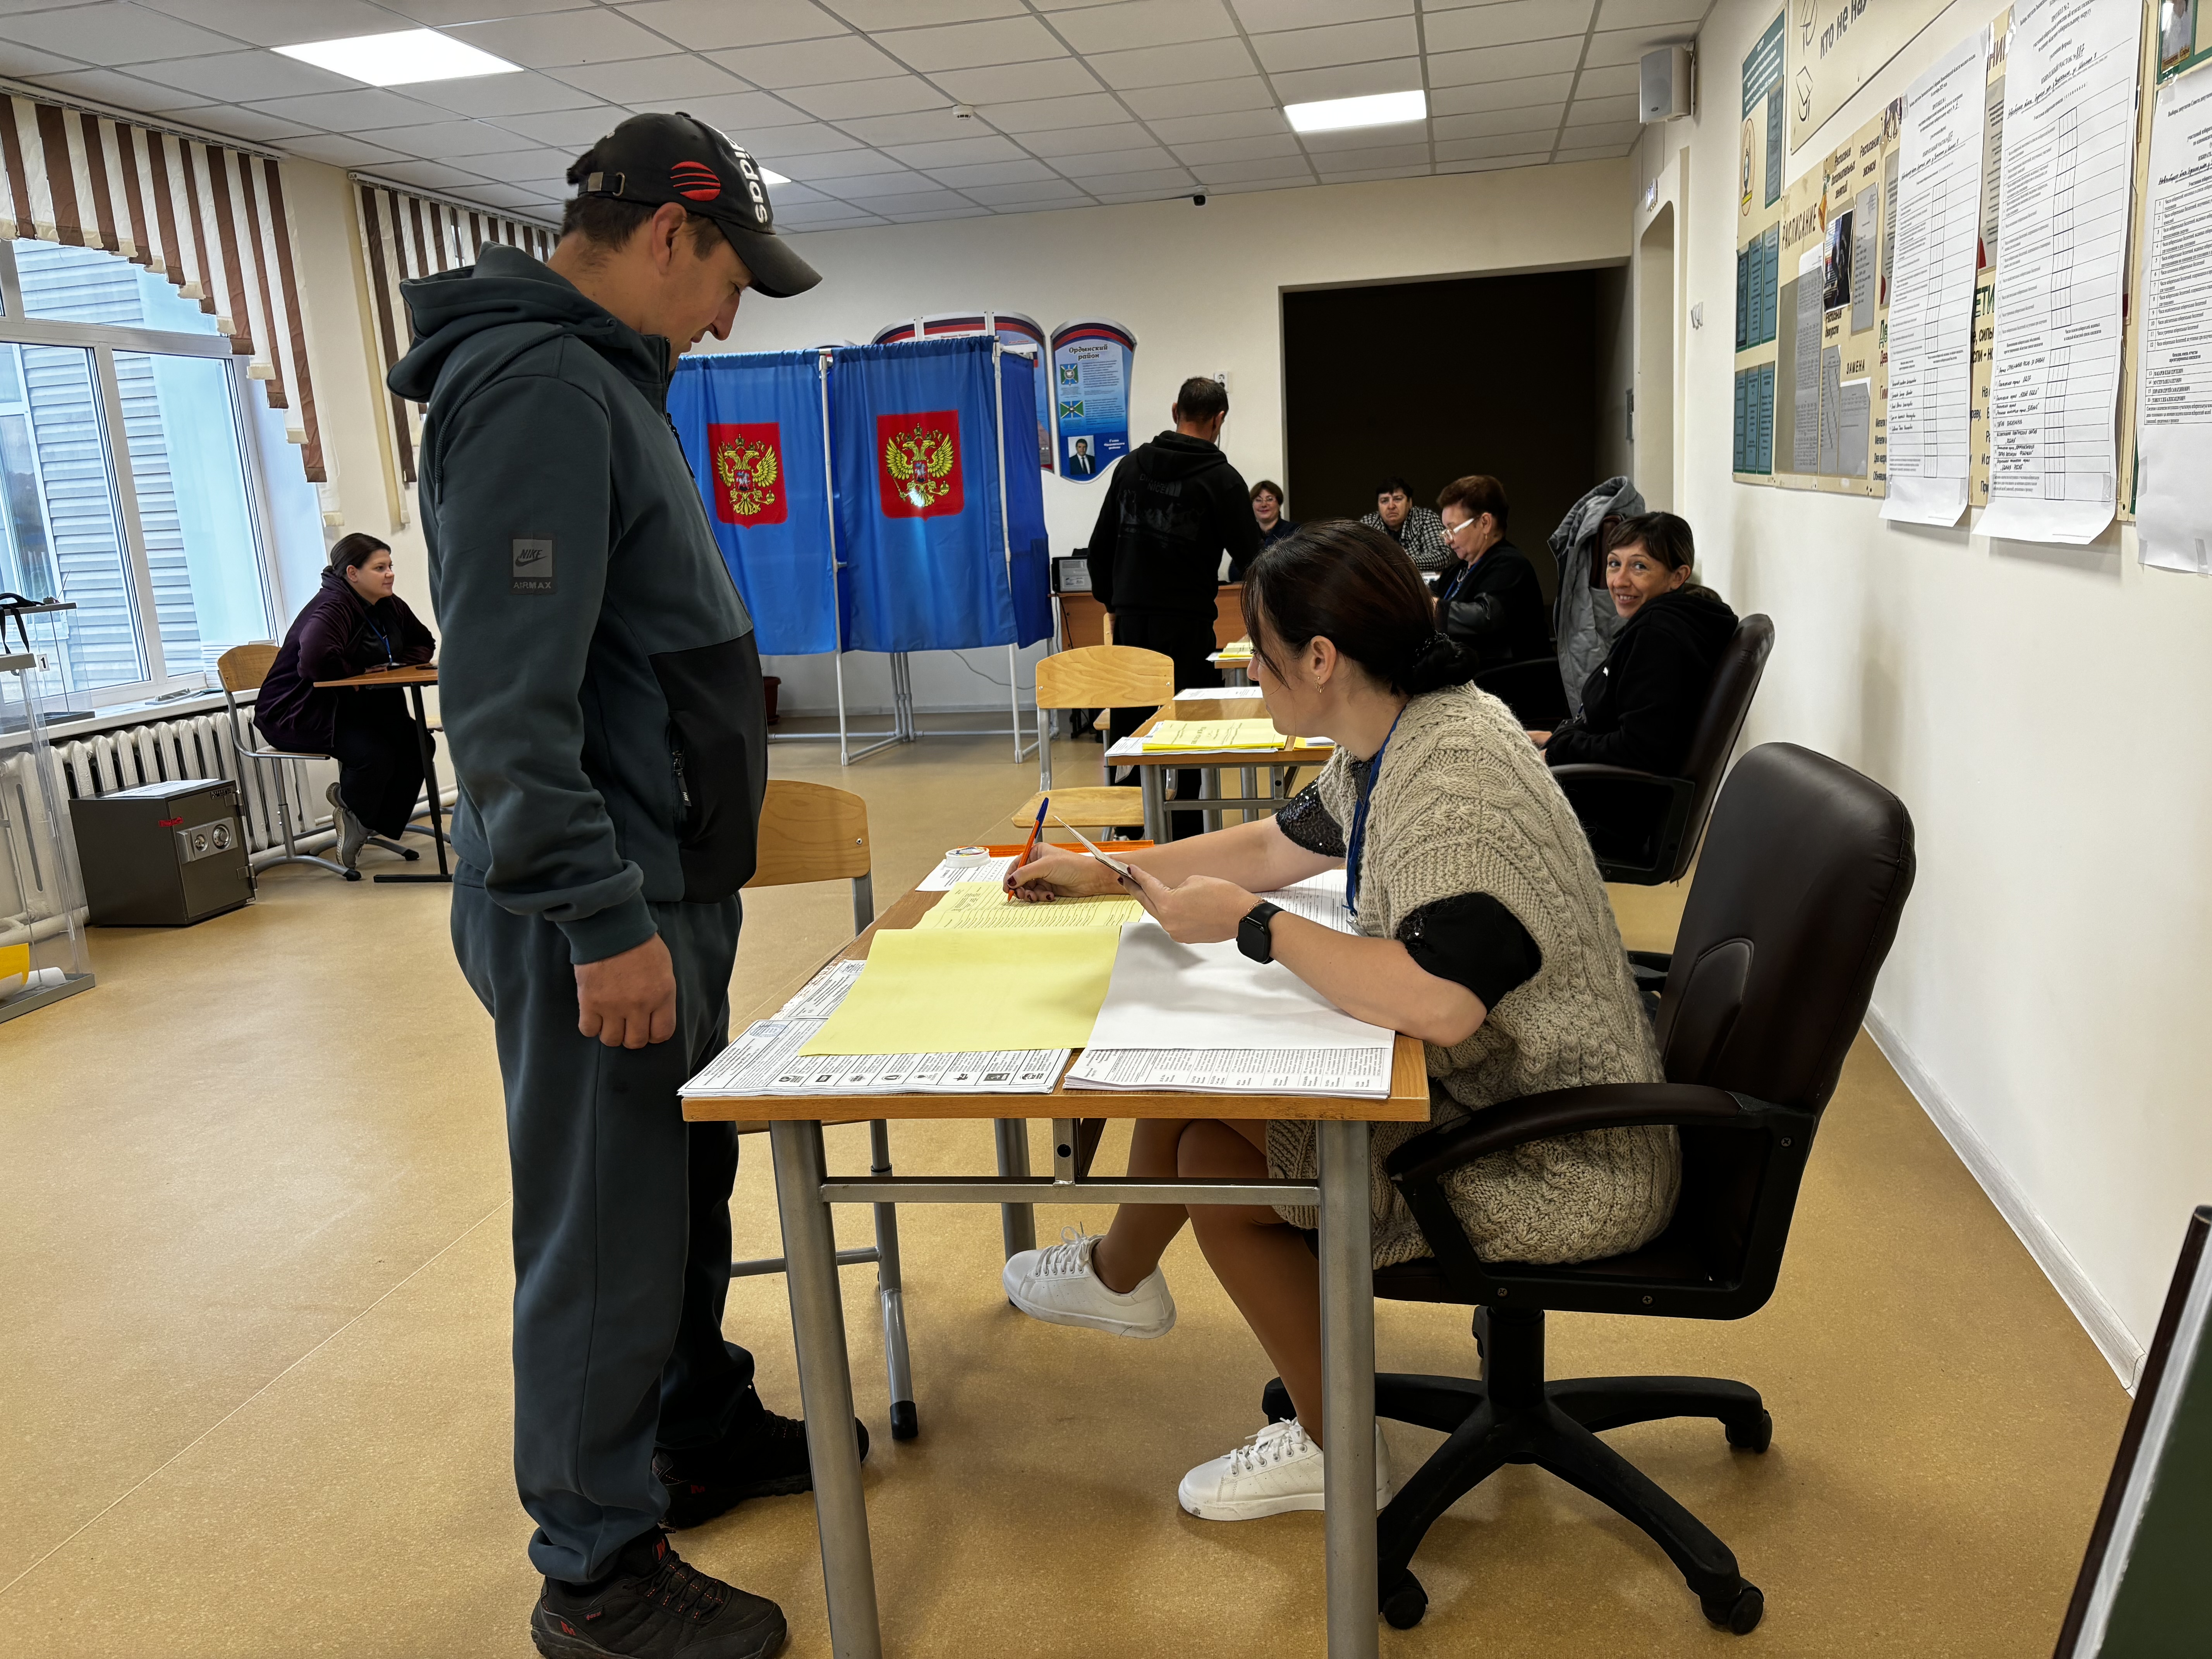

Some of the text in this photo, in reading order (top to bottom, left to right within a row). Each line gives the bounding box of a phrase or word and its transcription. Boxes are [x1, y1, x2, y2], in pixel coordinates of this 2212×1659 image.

[718, 128, 768, 224] didas
[1782, 203, 1817, 251] РАСПИСАНИЕ
[1069, 344, 1108, 354] Ордынский
[1078, 353, 1099, 361] район
[1846, 359, 1865, 374] ЗАМЕНА
[519, 549, 543, 559] NIKE
[41, 657, 46, 668] 1
